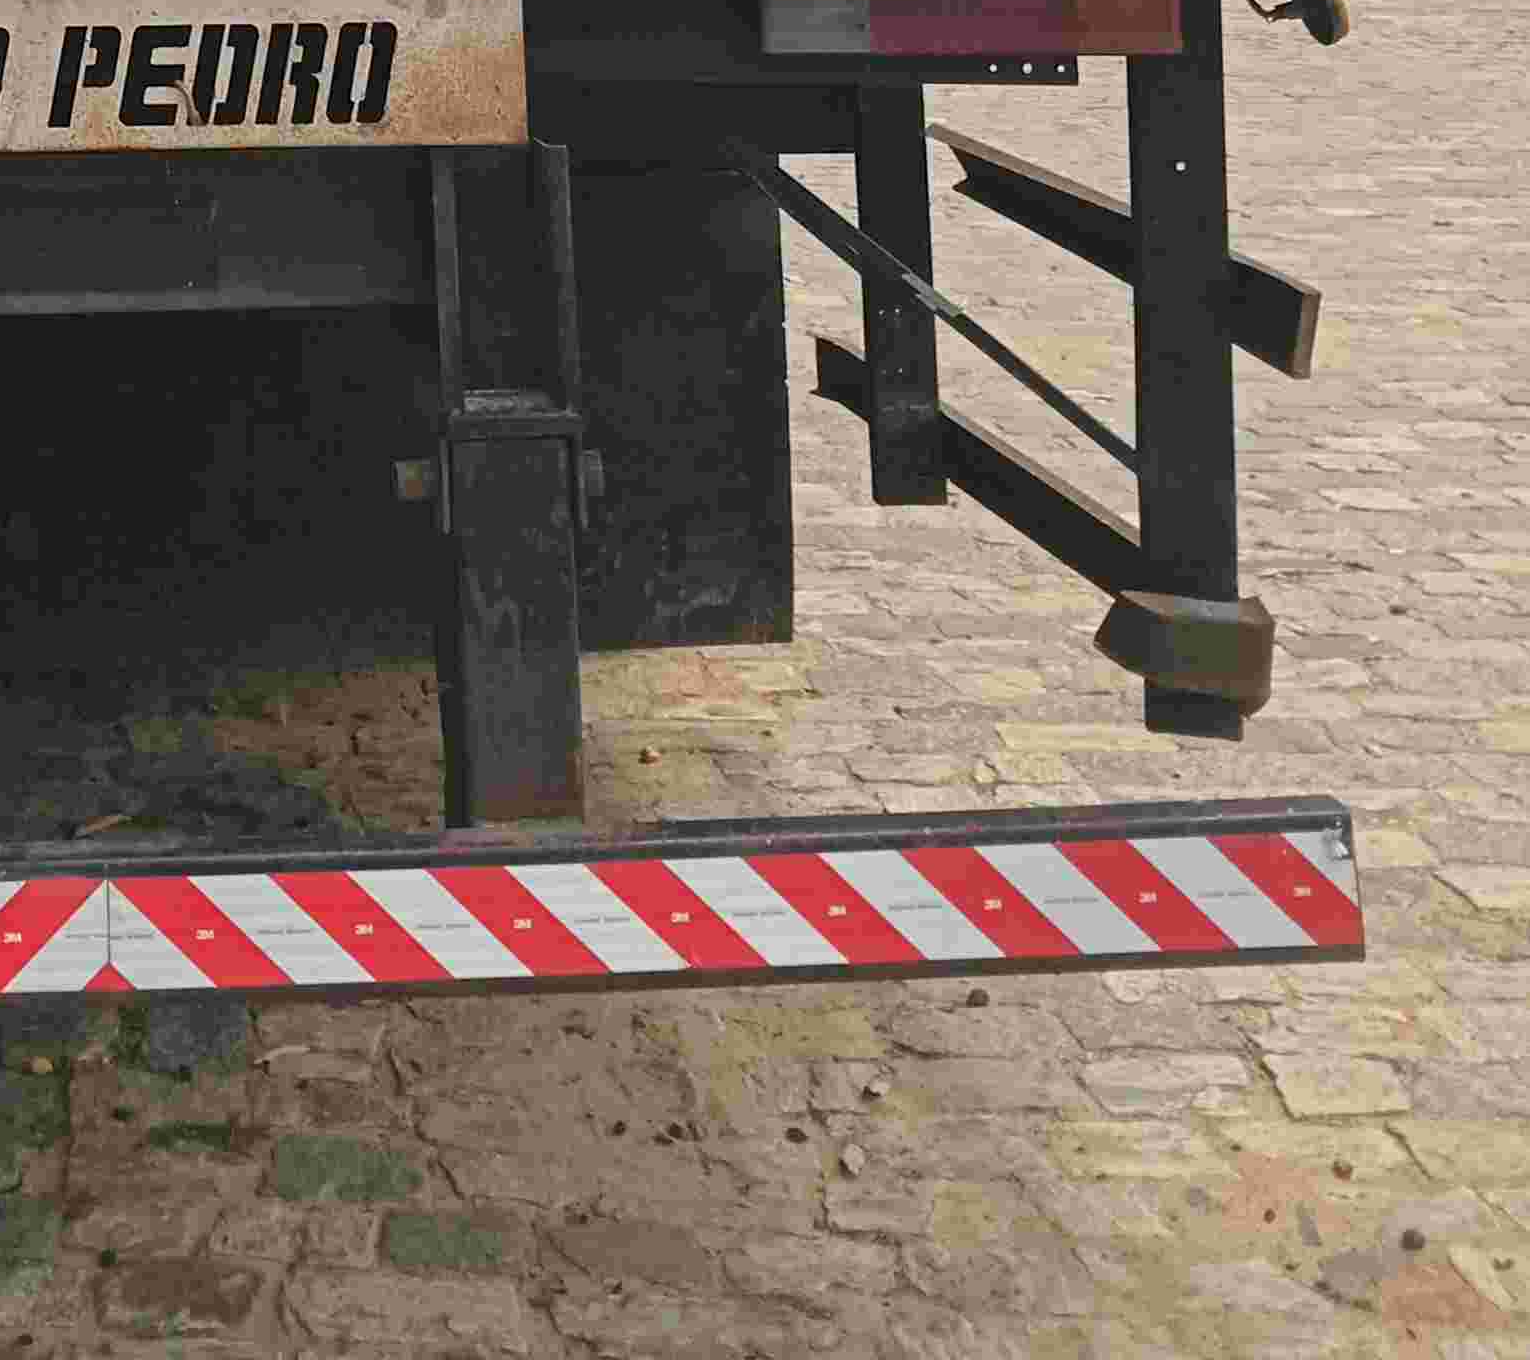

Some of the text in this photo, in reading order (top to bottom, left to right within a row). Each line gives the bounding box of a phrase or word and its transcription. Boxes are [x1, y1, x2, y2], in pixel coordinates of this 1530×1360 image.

[47, 22, 399, 128] PEDRO
[984, 898, 1003, 910] 3M
[827, 905, 847, 917] 3M
[671, 911, 690, 923] 3M
[513, 918, 533, 929] 3M
[196, 929, 215, 940] 3M
[355, 924, 374, 935] 3M
[3, 932, 23, 943] 3M
